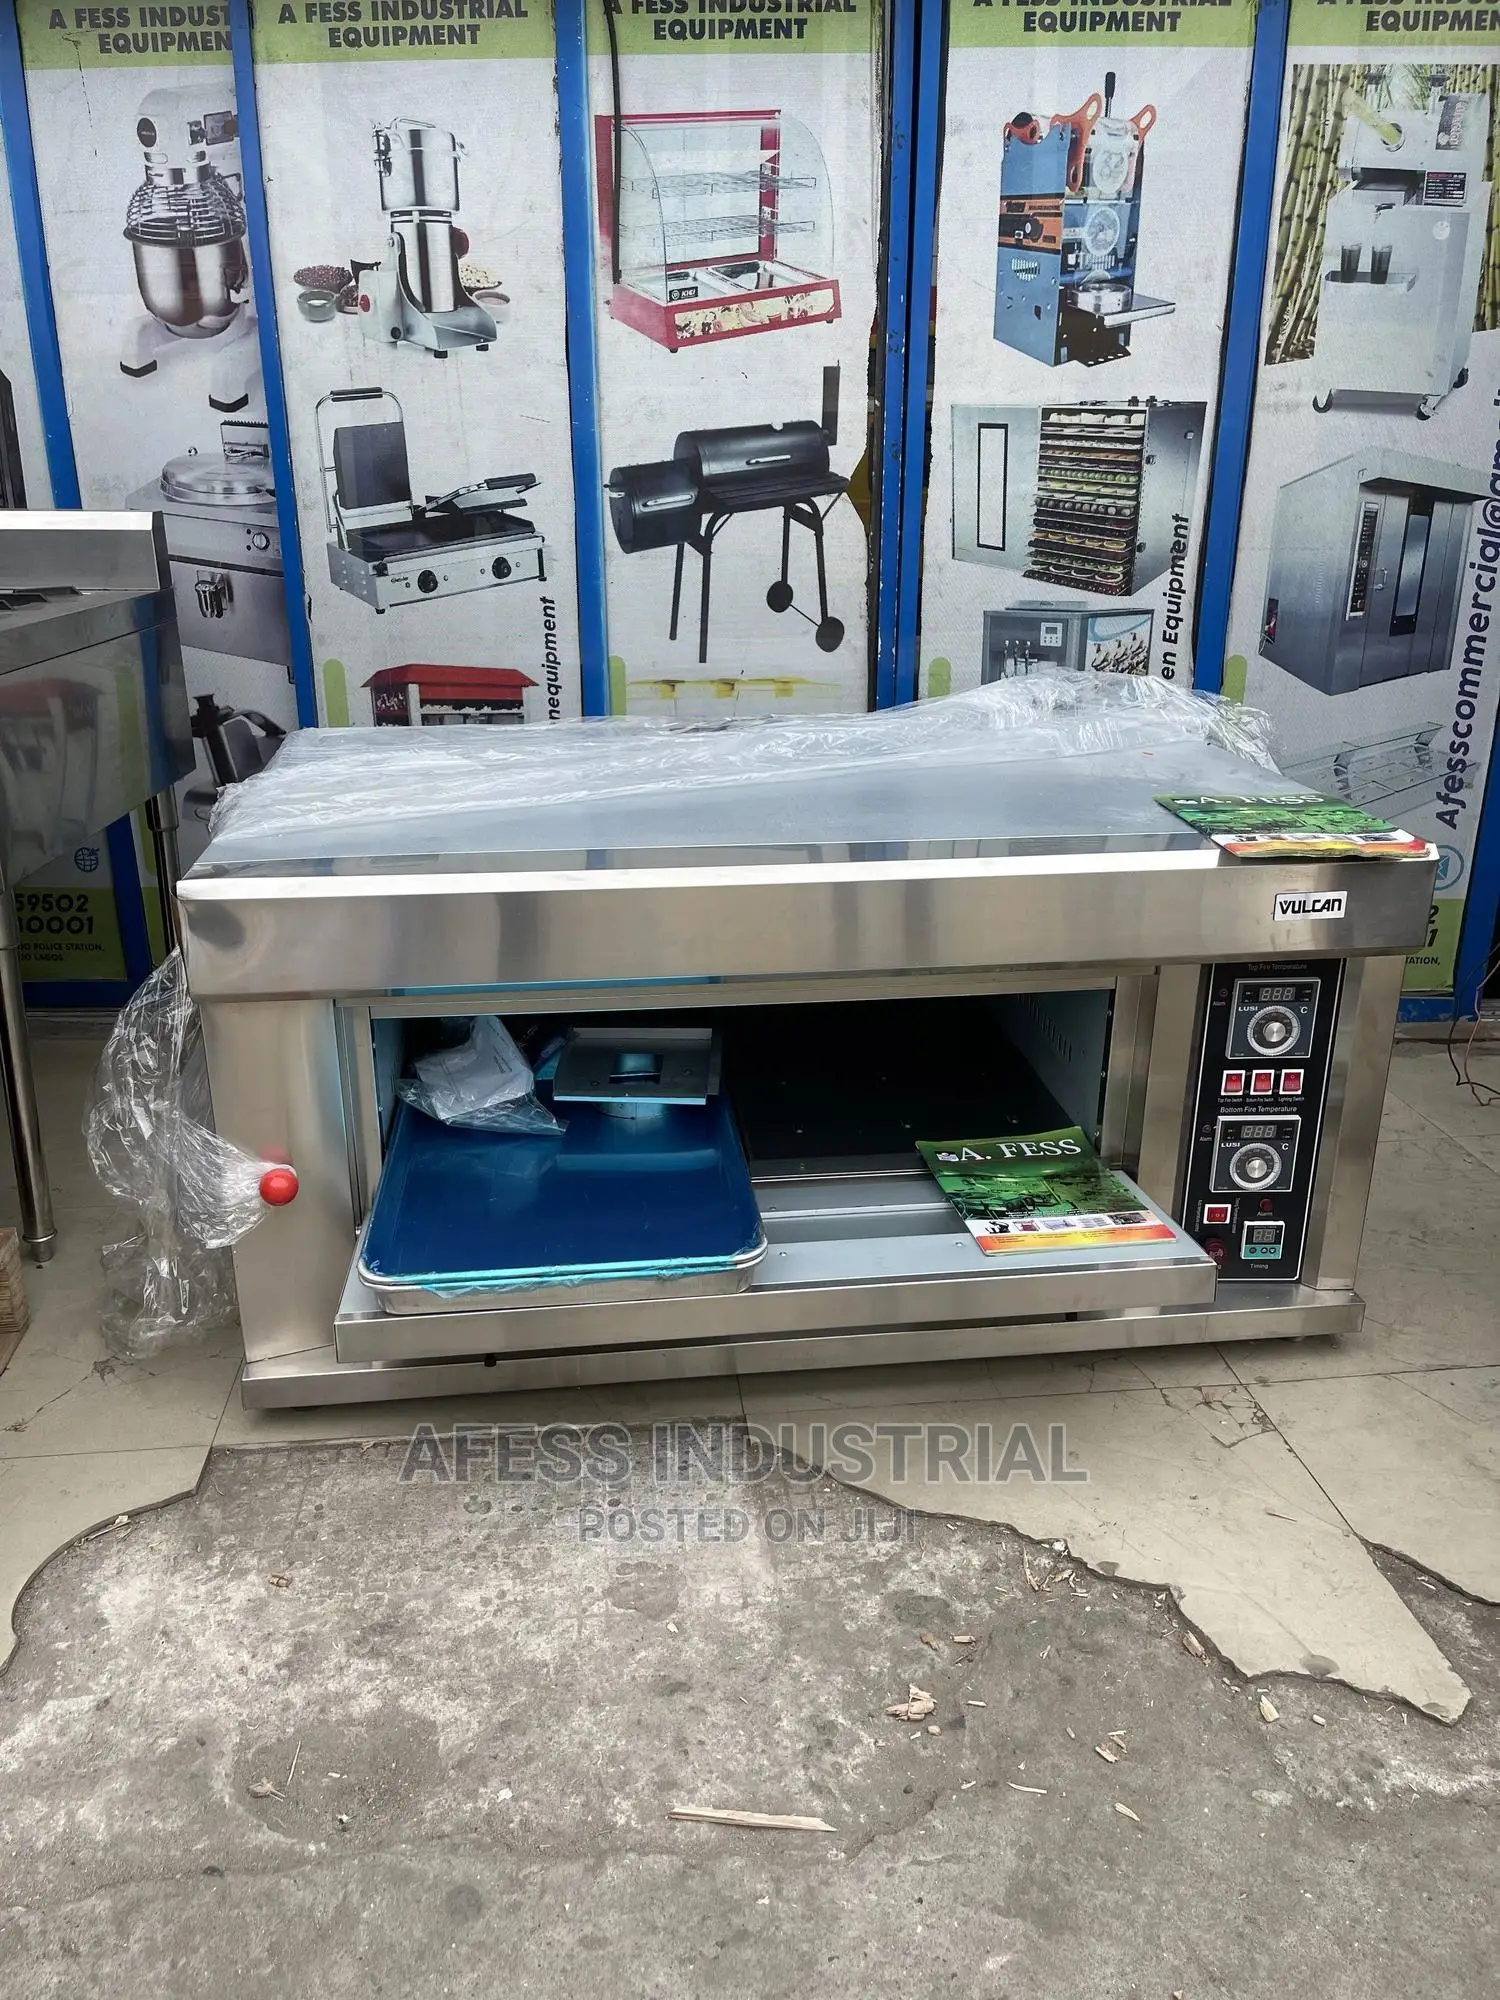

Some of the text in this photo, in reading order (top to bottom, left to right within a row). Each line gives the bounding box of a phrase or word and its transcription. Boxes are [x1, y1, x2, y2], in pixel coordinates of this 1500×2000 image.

[49, 9, 67, 29] A
[75, 7, 130, 28] FESS
[278, 0, 528, 24] A FESS INDUSTRIAL
[1023, 11, 1181, 33] EQUIPMENT
[328, 24, 480, 48] EQUIPMENT
[653, 18, 808, 41] EQUIPMENT
[1162, 513, 1189, 645] Equipment
[1279, 898, 1343, 914] VULCAN
[1258, 1105, 1298, 1113] Temperature
[996, 1138, 1082, 1158] FESS
